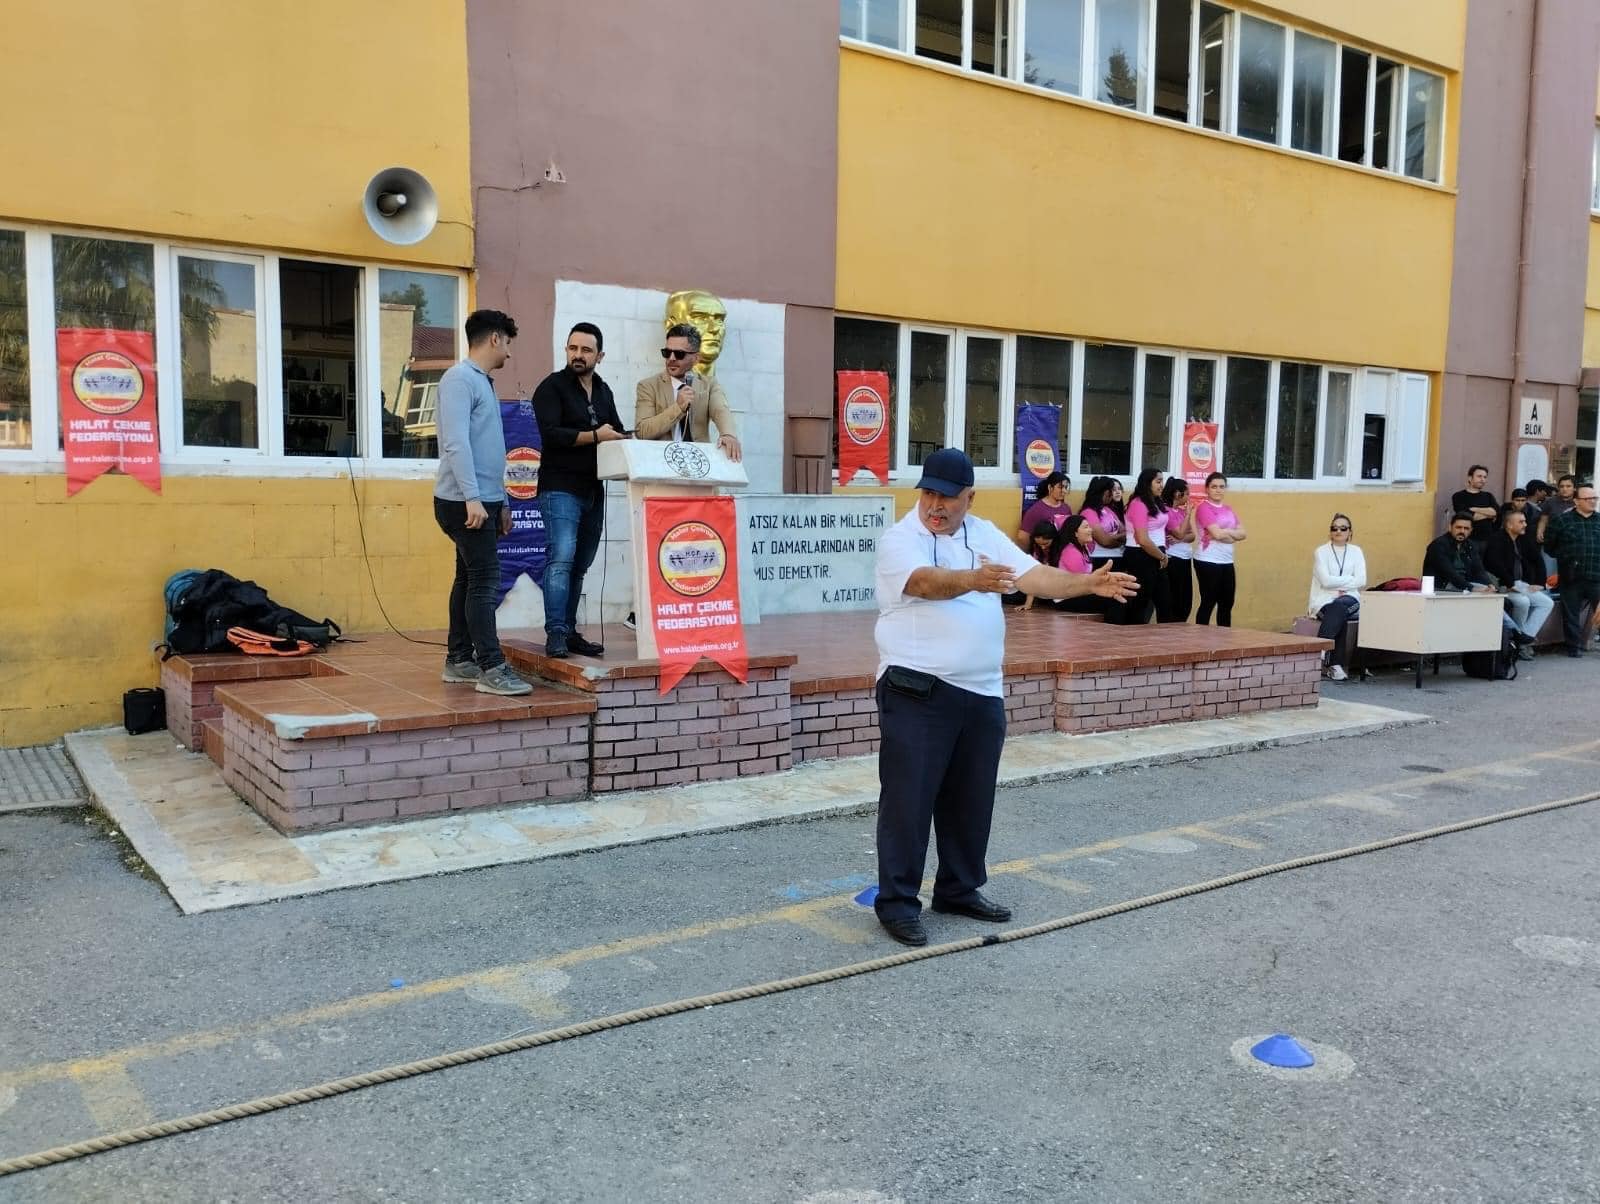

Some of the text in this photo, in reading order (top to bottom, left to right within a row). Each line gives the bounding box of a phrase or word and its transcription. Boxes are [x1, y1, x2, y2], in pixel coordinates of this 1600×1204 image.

[1531, 403, 1538, 421] A
[70, 420, 151, 432] HALAT ÇEKME
[1524, 423, 1543, 436] BLOK
[69, 432, 154, 442] FEDERASYONU
[750, 512, 884, 528] ATSIZ KALAN BİR MİLLETİN
[751, 537, 876, 554] AT DAMARLARINDAN BİRİ
[779, 564, 832, 580] DEMEKTİR.
[657, 600, 734, 616] HALAT ÇEKME
[657, 614, 737, 631] FEDERASYONU
